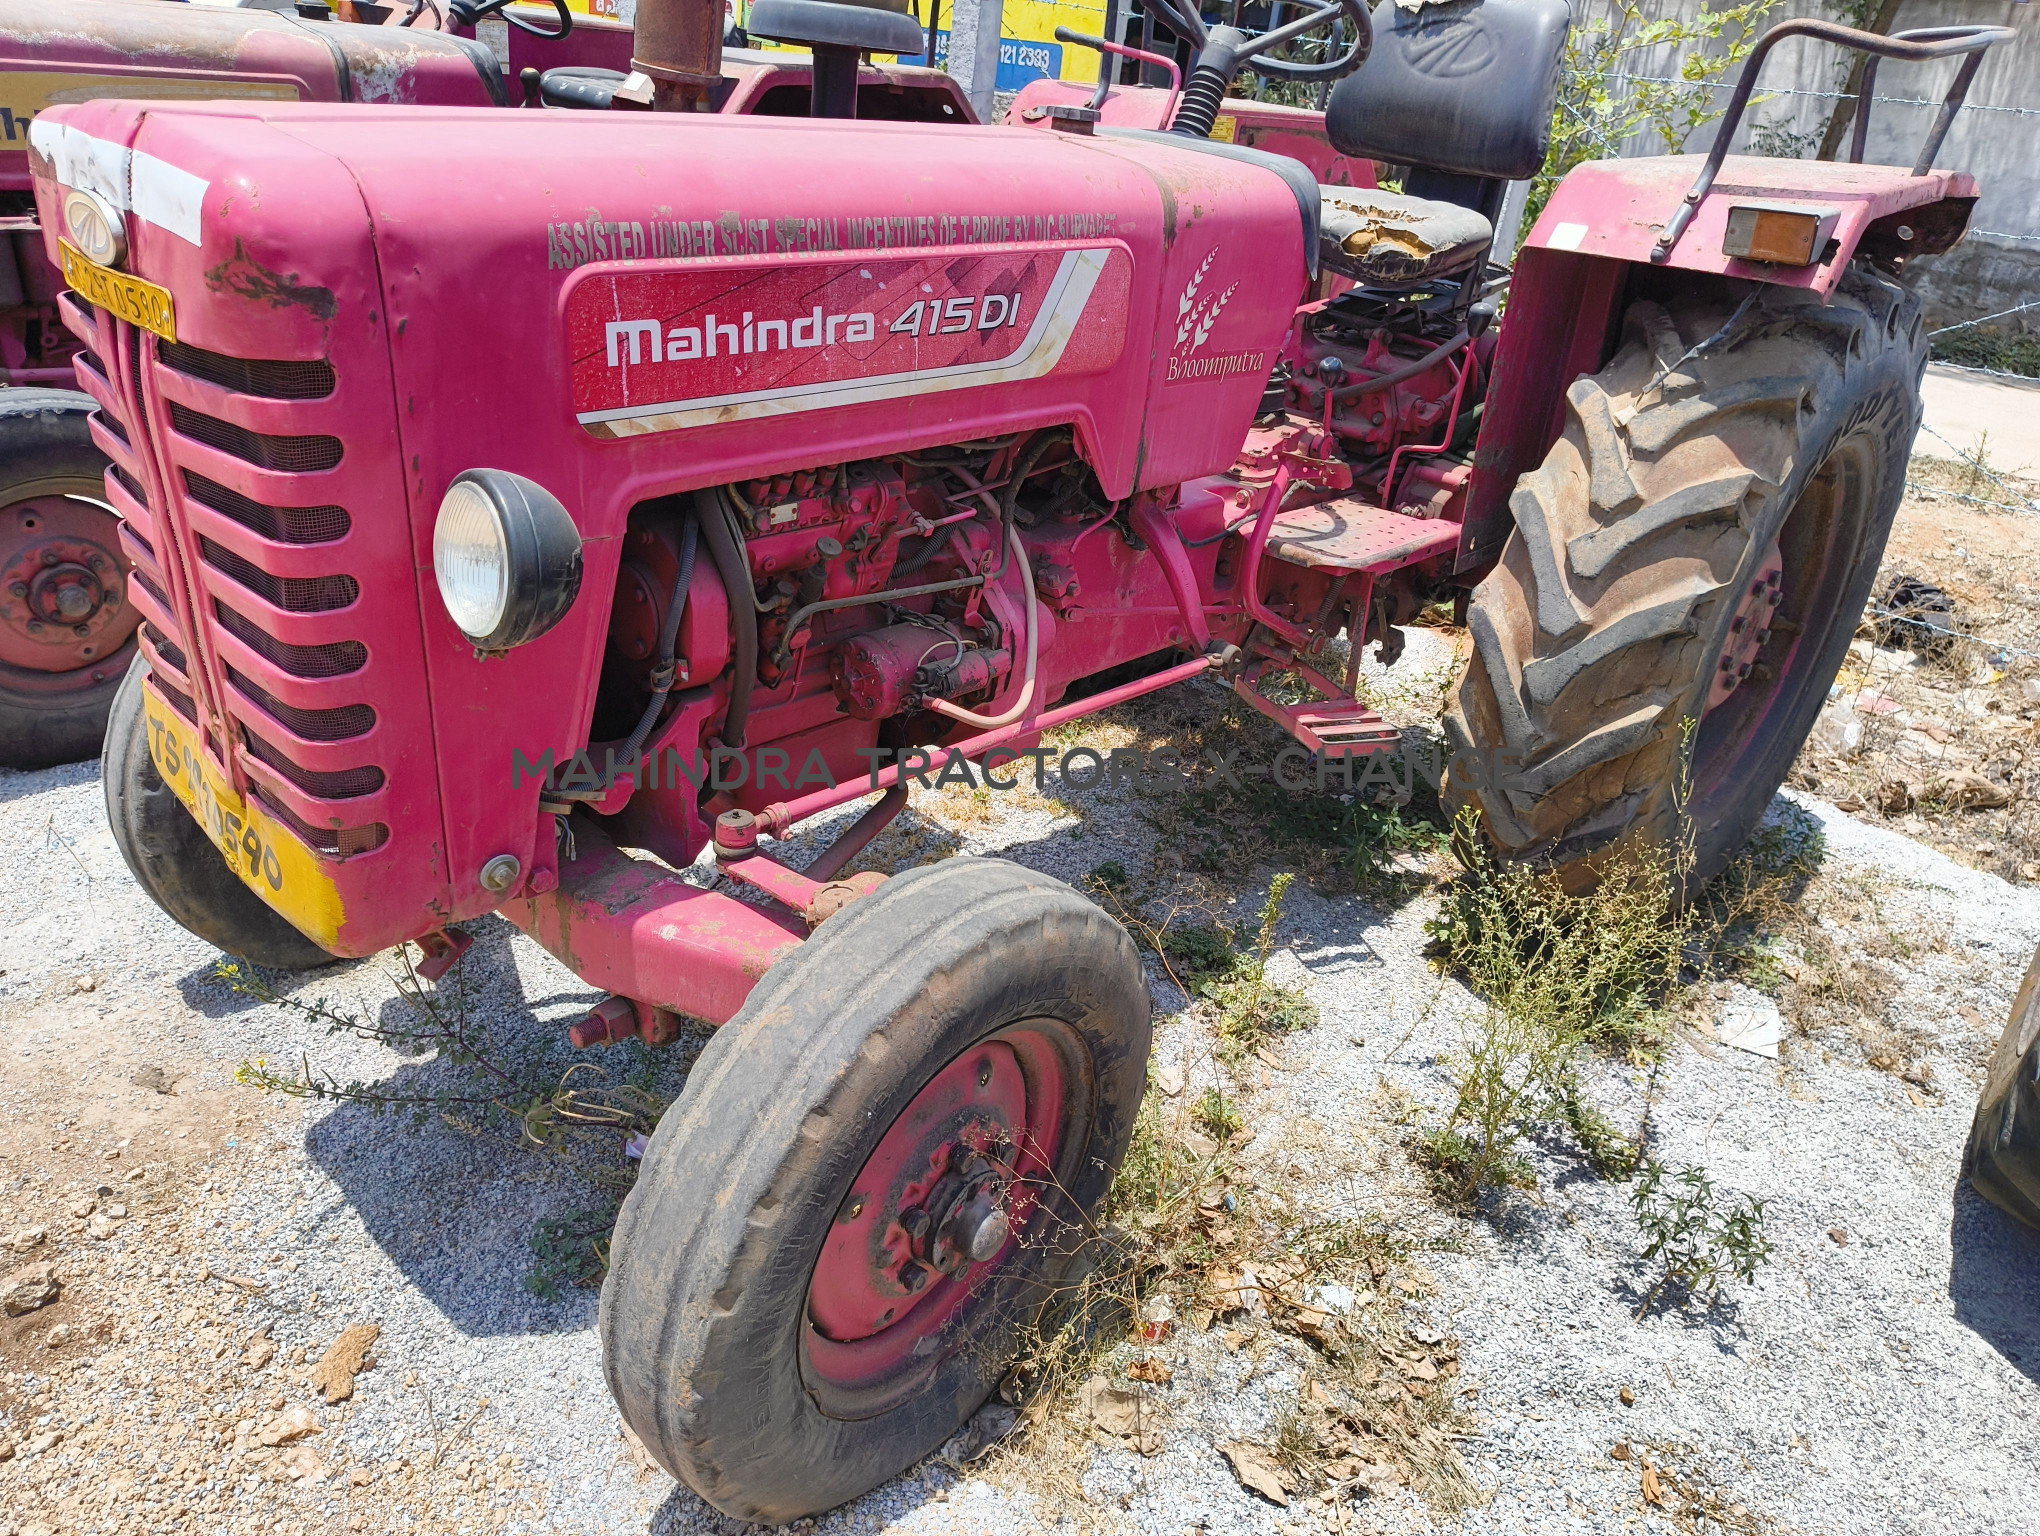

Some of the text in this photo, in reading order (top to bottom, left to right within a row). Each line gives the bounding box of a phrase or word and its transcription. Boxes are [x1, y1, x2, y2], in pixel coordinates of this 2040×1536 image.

[547, 221, 646, 270] ASSISTED
[650, 220, 719, 265] UNDER
[776, 217, 844, 259] SPECIAL
[1014, 215, 1031, 249] BY
[1166, 348, 1264, 384] Bhoomiputra
[149, 713, 181, 776] TS
